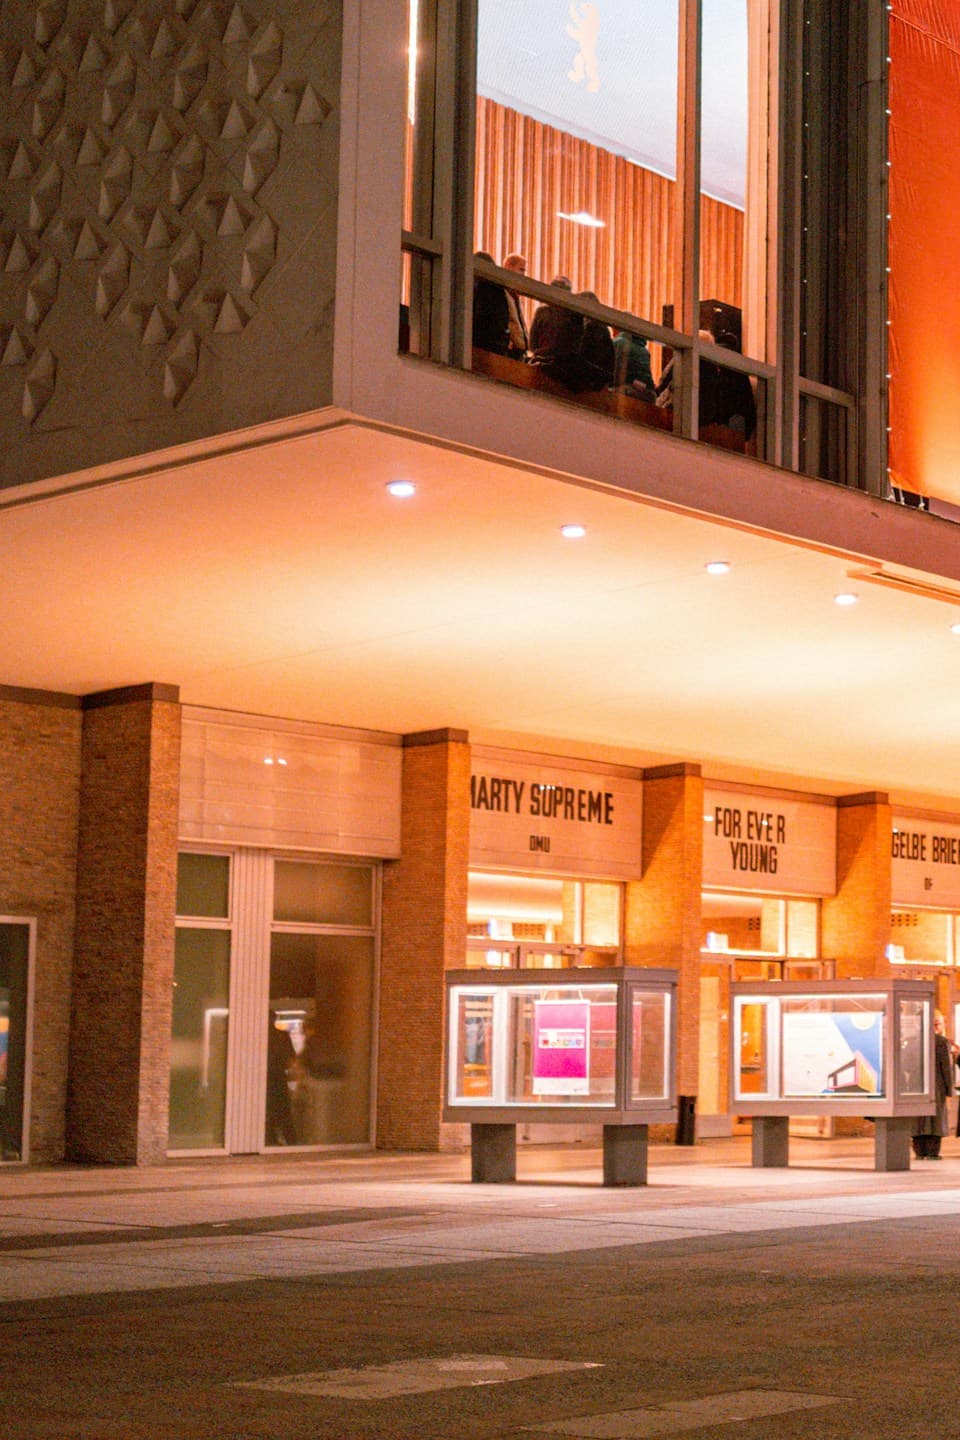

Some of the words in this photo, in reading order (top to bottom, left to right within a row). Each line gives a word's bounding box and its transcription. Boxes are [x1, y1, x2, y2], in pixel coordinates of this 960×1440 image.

[529, 783, 615, 825] SUPREME
[714, 806, 742, 840] FOR
[730, 841, 778, 874] YOUNG
[891, 832, 927, 861] GELBE
